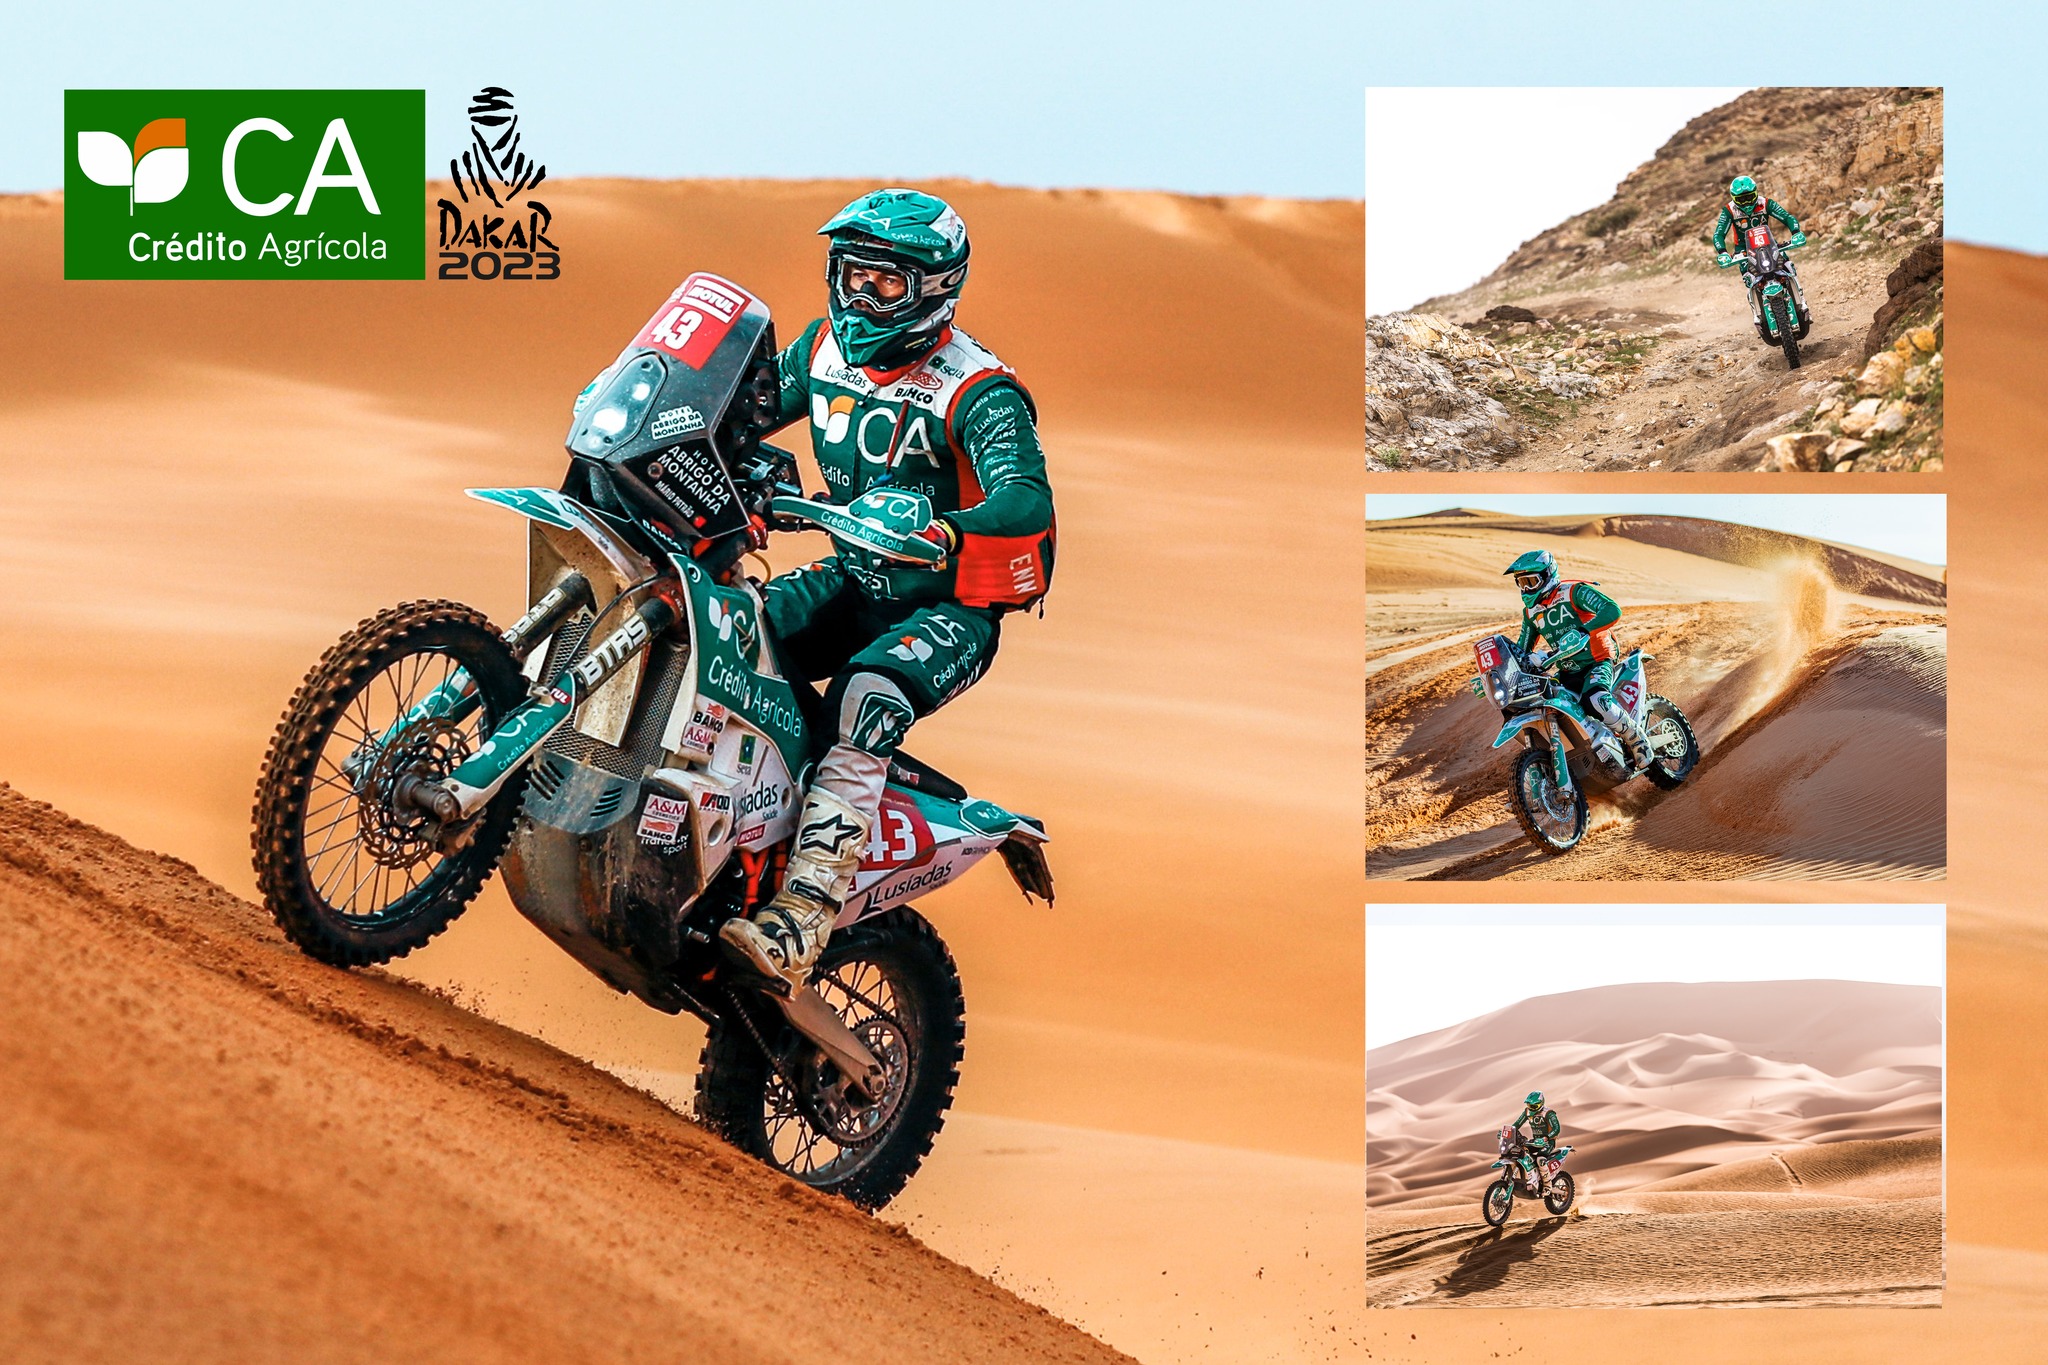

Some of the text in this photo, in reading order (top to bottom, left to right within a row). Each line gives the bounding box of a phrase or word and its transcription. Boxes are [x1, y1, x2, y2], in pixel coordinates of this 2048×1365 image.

[858, 209, 892, 231] CA
[1751, 215, 1767, 227] CA
[1754, 234, 1765, 246] 43
[687, 286, 736, 313] MOTUL
[650, 306, 704, 350] 43
[894, 387, 934, 405] BAHCO
[653, 413, 701, 430] ABRIGO DA
[653, 422, 704, 437] MONTANHA
[857, 406, 941, 468] CA
[668, 445, 732, 505] ABRIGO DA
[692, 450, 728, 483] HOTEL
[817, 460, 936, 496] rédito Arícola
[657, 453, 722, 515] MONTANHA
[887, 499, 919, 528] CA
[820, 510, 904, 551] Crédito Agrícola
[1546, 604, 1575, 626] CA
[1544, 631, 1553, 640] dito
[576, 613, 649, 687] BTRS
[1480, 651, 1494, 669] 43
[933, 663, 957, 688] Cédit
[551, 687, 568, 704] TUL
[708, 655, 802, 737] Crédito Agrícola
[1621, 684, 1640, 705] 43
[649, 797, 686, 816] A&M
[740, 783, 778, 814] síadas
[641, 828, 673, 841] BAHCO
[867, 809, 918, 863] 43
[873, 860, 953, 905] Lusíadas
[1533, 1116, 1545, 1125] CA
[1550, 1161, 1560, 1170] 43
